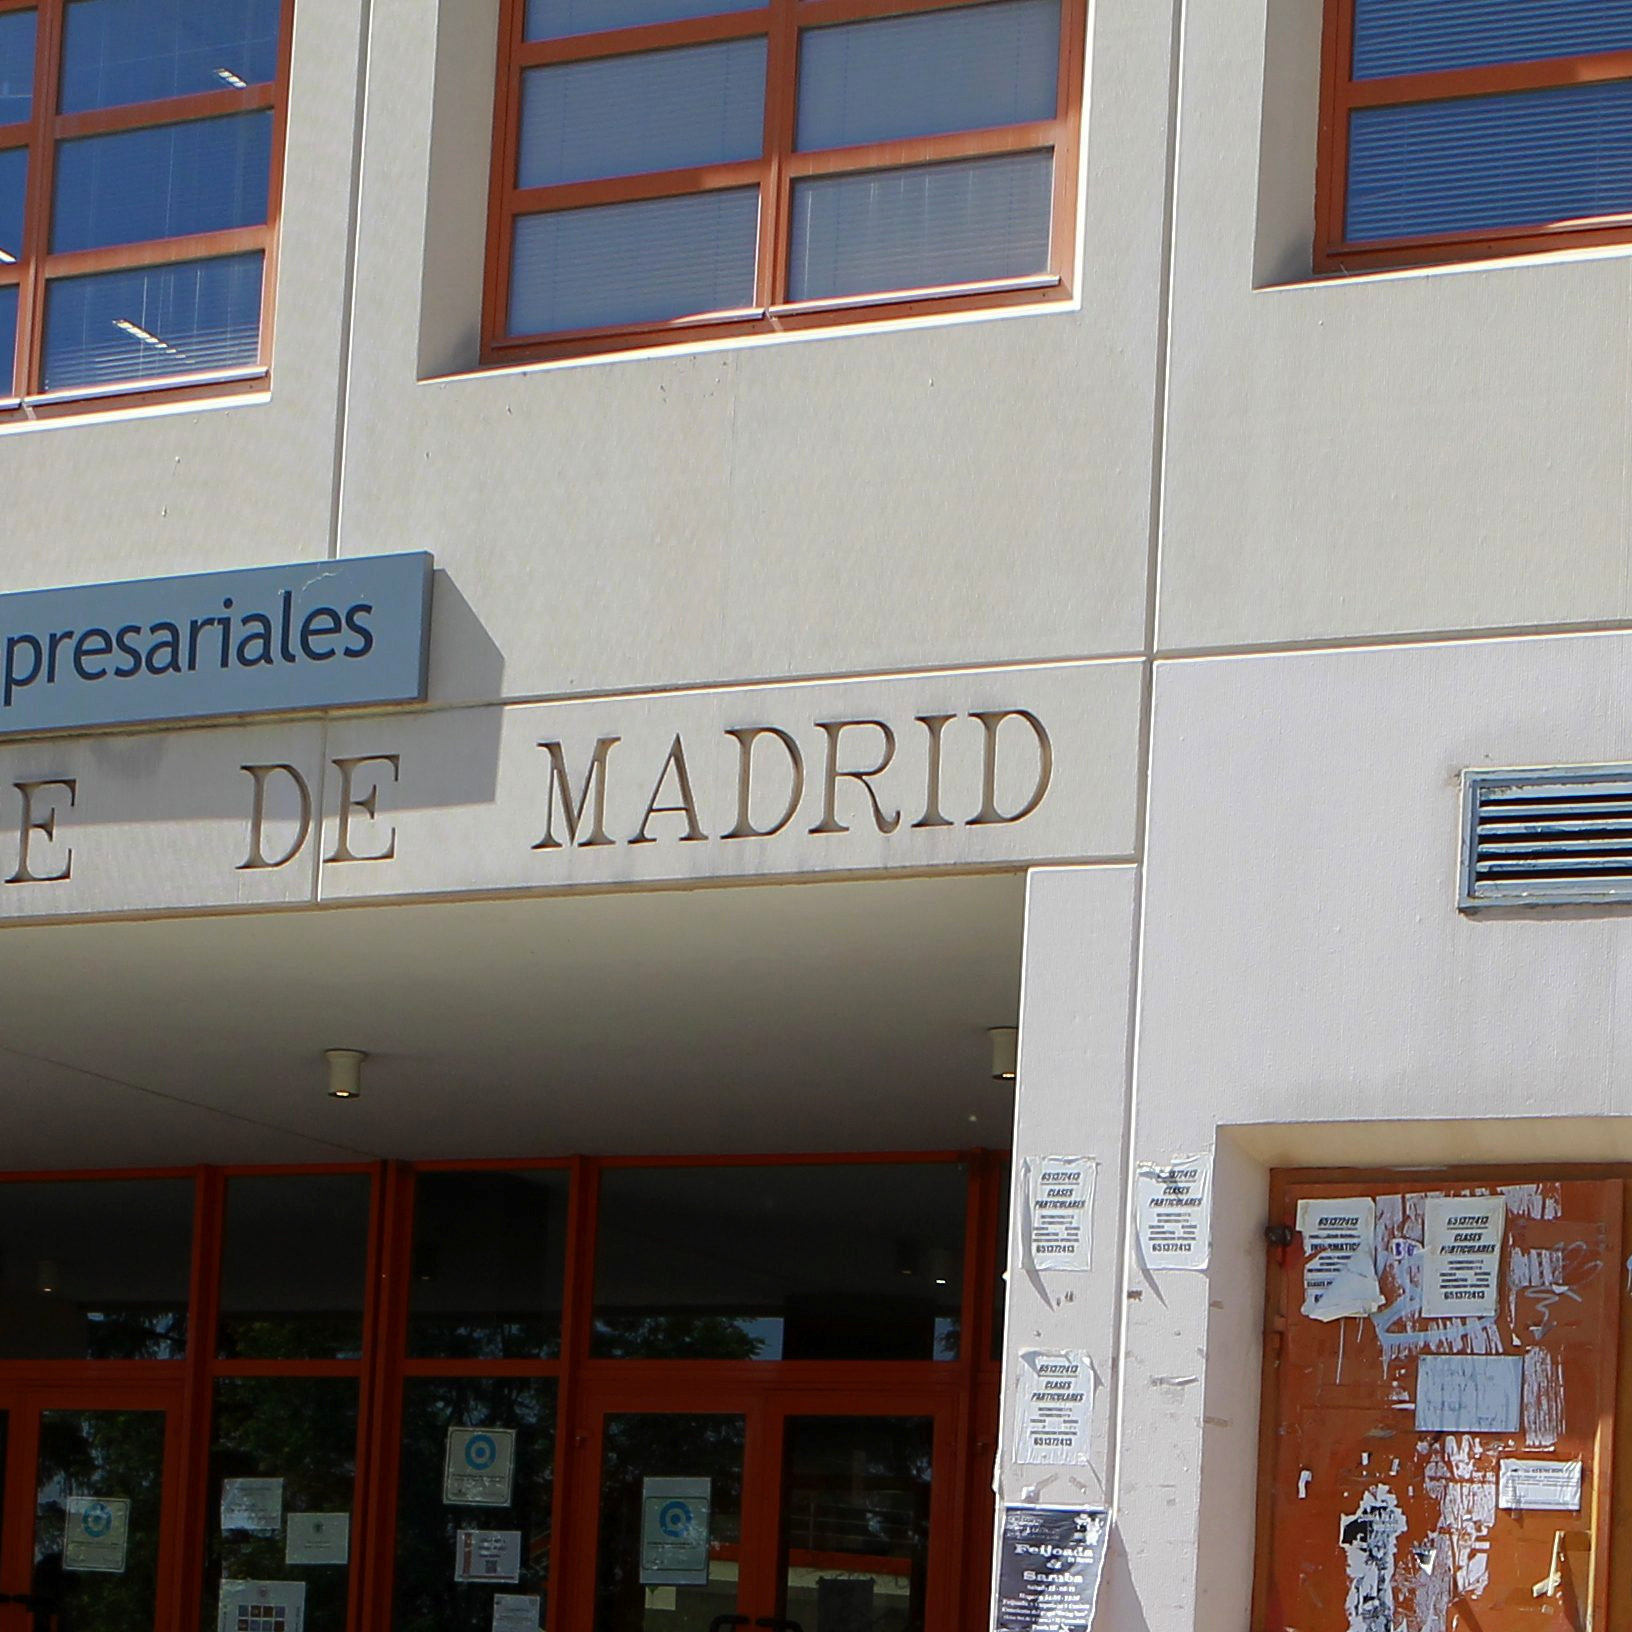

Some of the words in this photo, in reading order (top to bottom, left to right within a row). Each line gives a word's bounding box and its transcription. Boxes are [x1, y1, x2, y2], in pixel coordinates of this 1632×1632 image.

[235, 753, 402, 871] DE
[531, 708, 1055, 850] MADRID
[1034, 1200, 1086, 1209] PARTICULARES
[1149, 1198, 1202, 1207] PARTICULARES
[1454, 1232, 1483, 1242] CLASES
[1152, 1243, 1192, 1252] 651372413
[1444, 1291, 1485, 1300] 651372413
[1031, 1392, 1084, 1402] PARTICULARES
[1023, 1570, 1084, 1583] Samba
